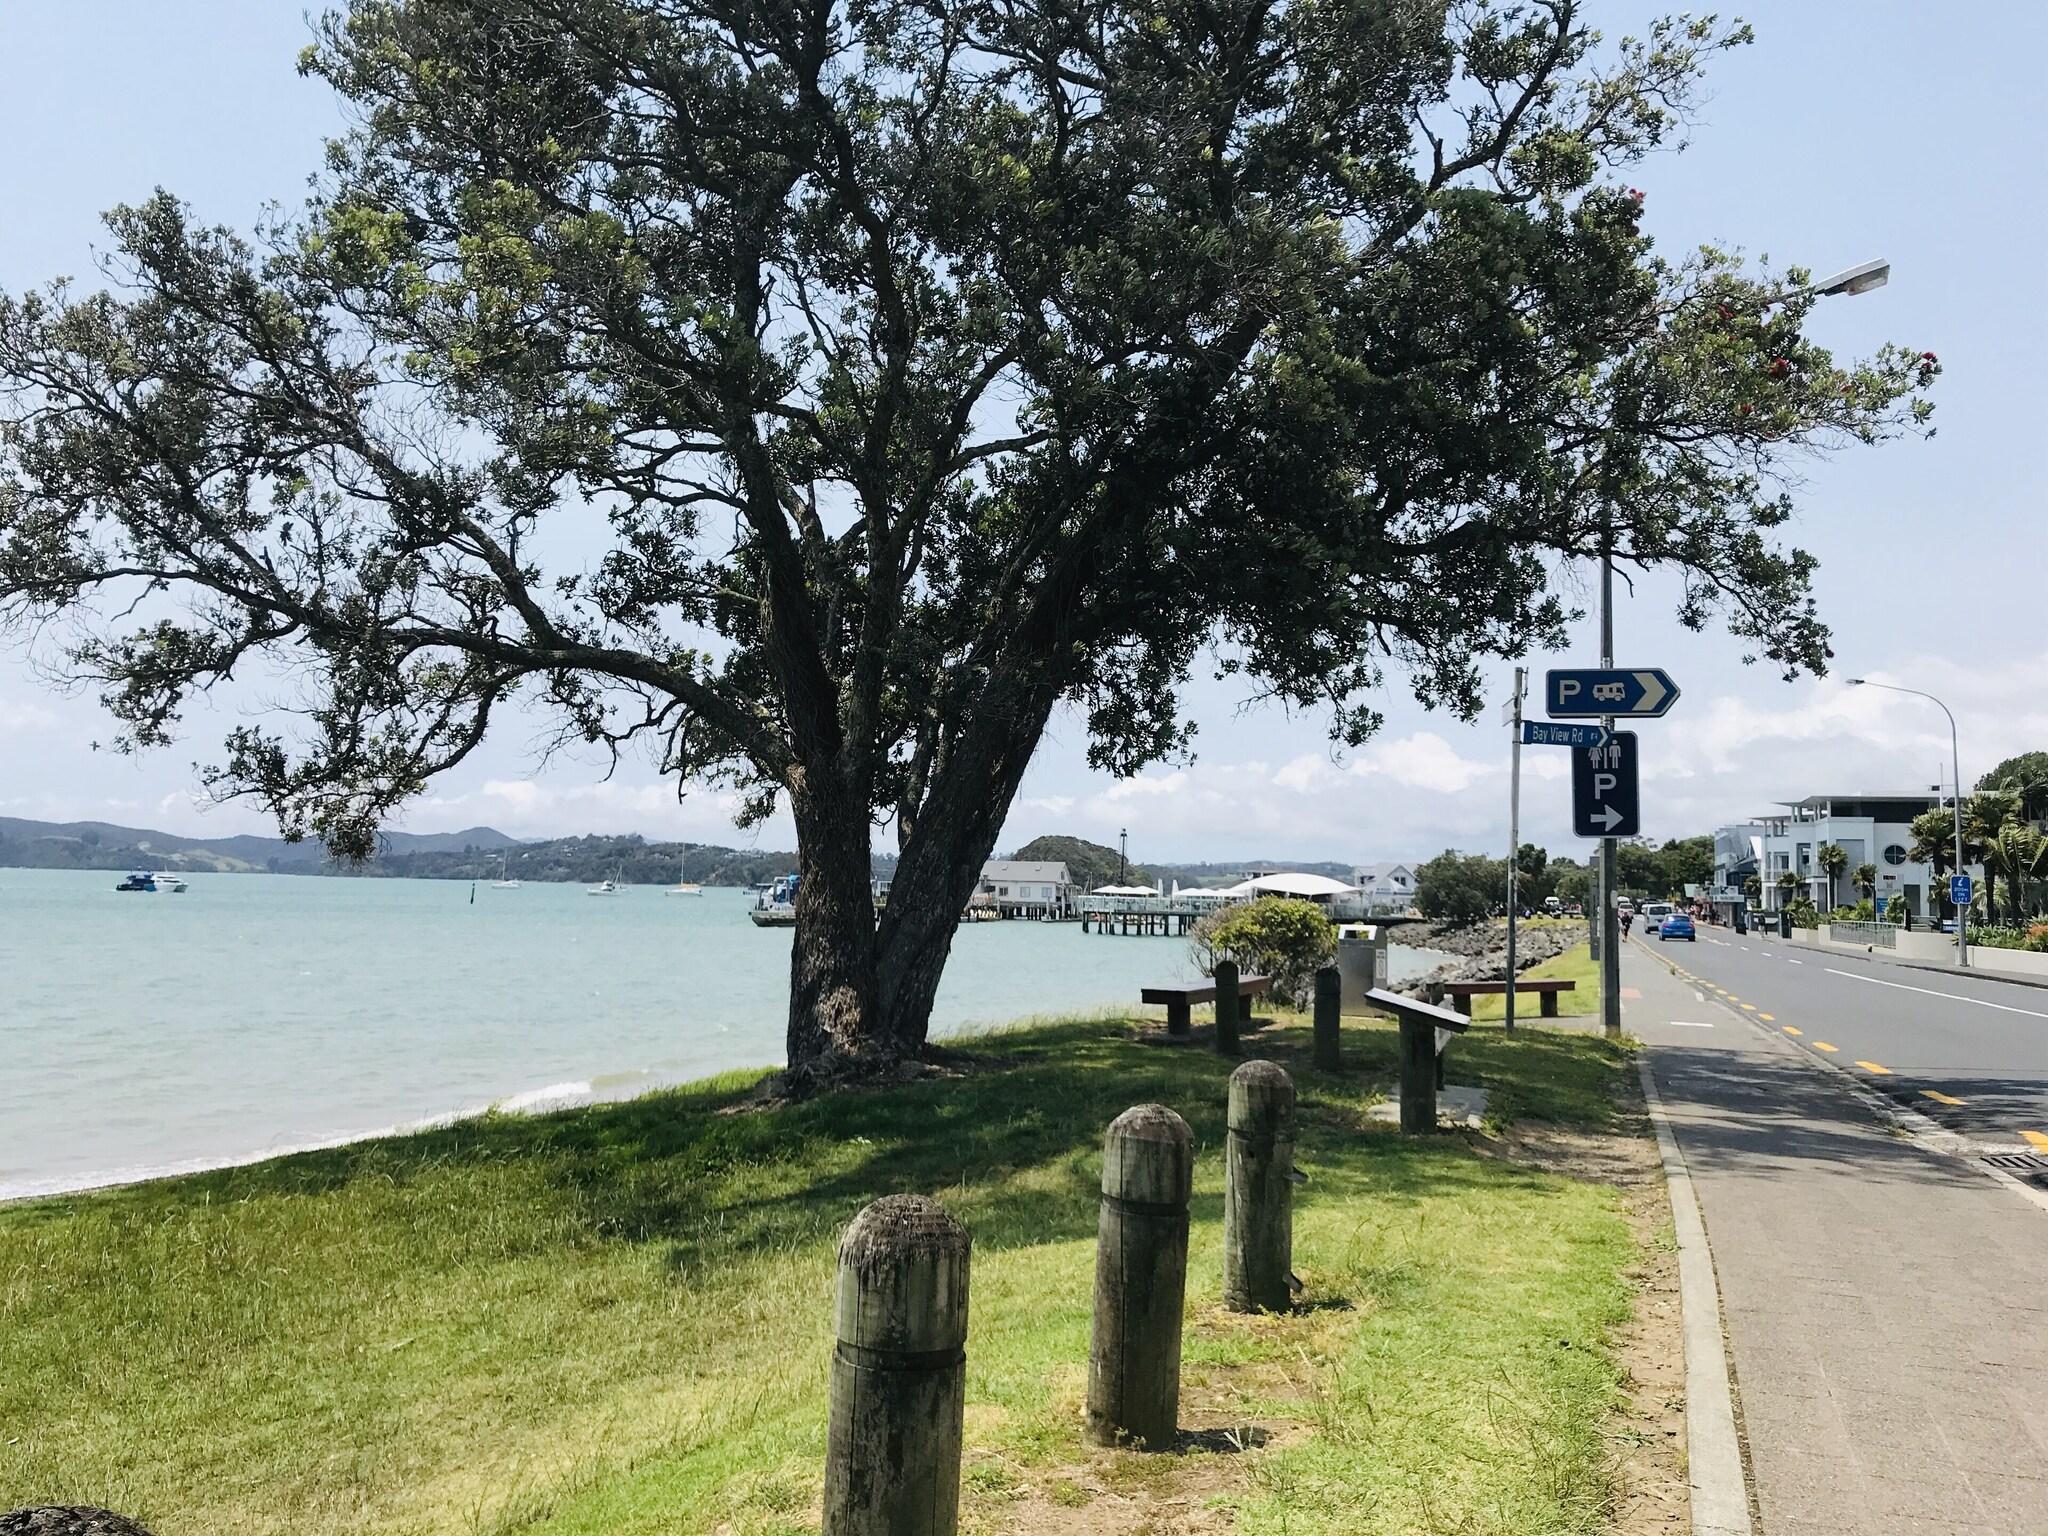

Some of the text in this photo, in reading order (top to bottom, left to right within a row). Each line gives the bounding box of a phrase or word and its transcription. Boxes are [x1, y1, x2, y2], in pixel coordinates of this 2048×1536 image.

[1559, 680, 1581, 705] P
[1532, 725, 1548, 743] Bay
[1550, 726, 1570, 742] View
[1571, 728, 1584, 743] Rd
[1594, 773, 1617, 800] P
